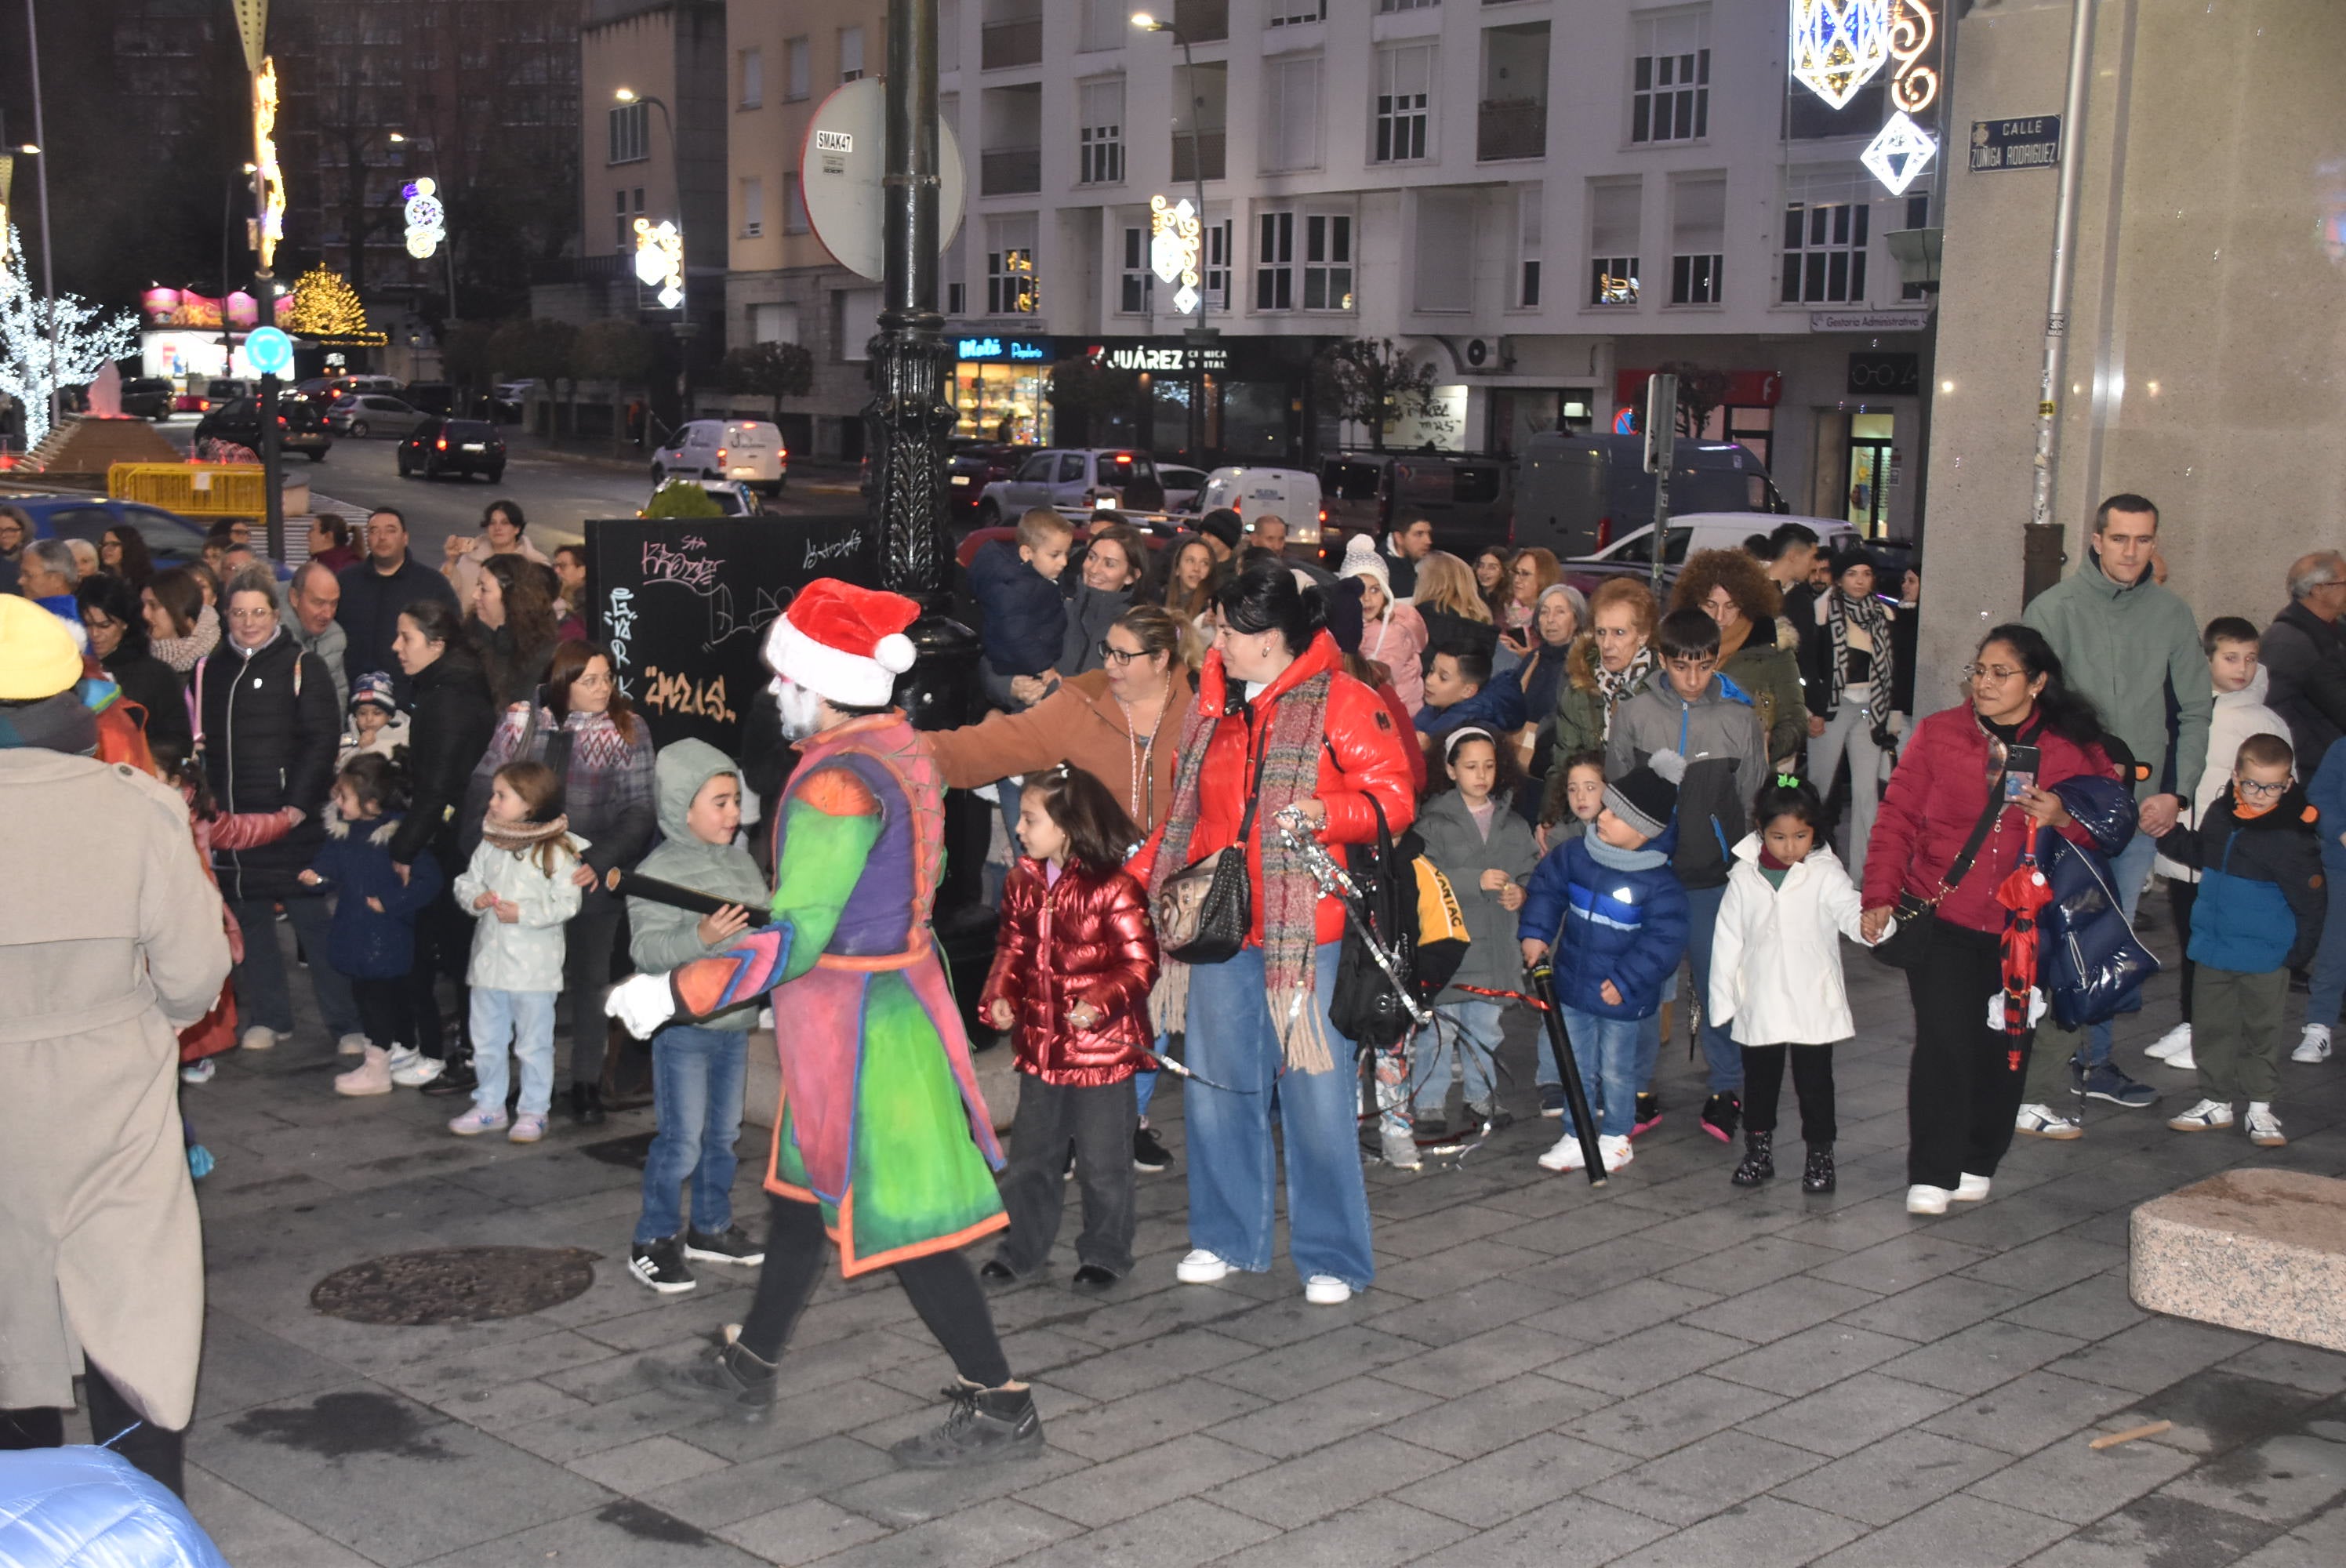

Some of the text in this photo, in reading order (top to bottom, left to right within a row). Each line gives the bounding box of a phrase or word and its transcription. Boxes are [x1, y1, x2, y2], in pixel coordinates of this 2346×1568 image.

[2003, 120, 2042, 136] CALLE
[819, 132, 851, 151] SMAK47
[1971, 145, 2001, 168] ZUÑIGA
[1862, 316, 1919, 326] Administrativa
[1106, 345, 1183, 369] JUÁREZ
